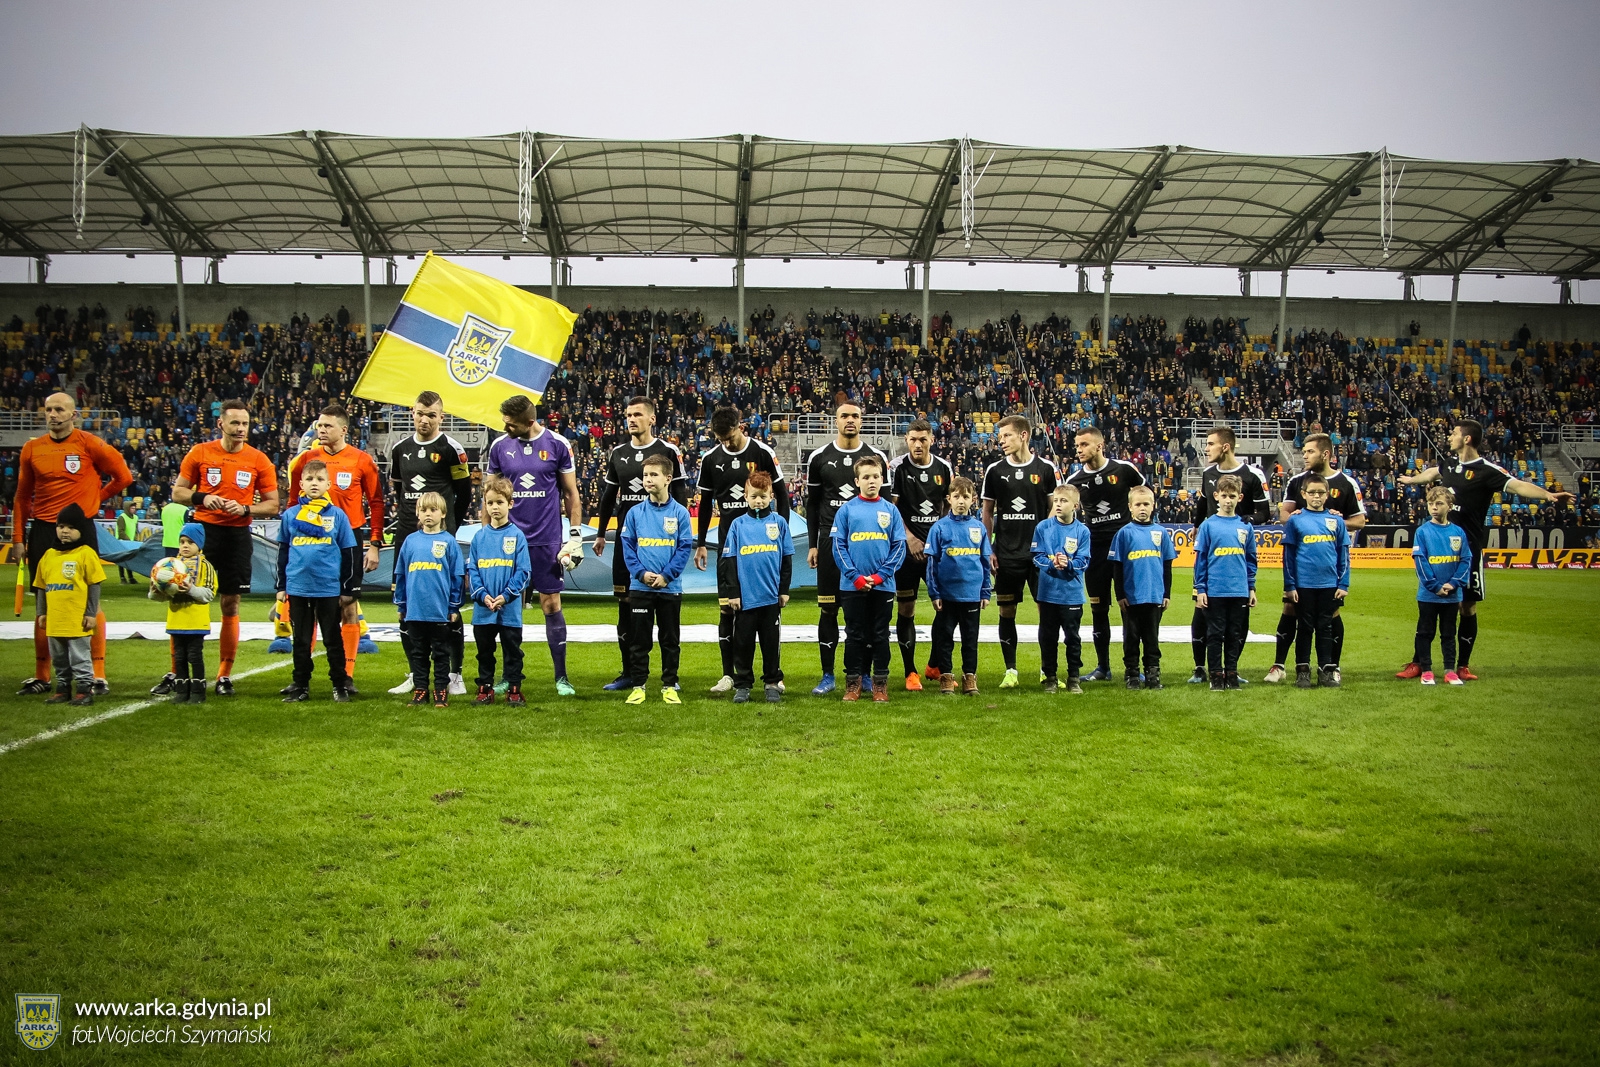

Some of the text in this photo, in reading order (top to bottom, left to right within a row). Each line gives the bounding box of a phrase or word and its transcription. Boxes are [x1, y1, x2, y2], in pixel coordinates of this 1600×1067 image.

[457, 351, 488, 367] ARKA
[466, 433, 479, 443] 15
[871, 437, 883, 446] 16
[1261, 440, 1273, 449] 17
[1091, 512, 1121, 524] SUZUKI
[850, 531, 888, 542] GDYNIA
[637, 538, 675, 547] GDYNIA
[740, 544, 778, 555] GDYNIA
[946, 547, 981, 556] GDYNIA
[408, 561, 442, 572] GDYNIA
[477, 557, 514, 568] GDYNIA
[1472, 571, 1480, 588] 3
